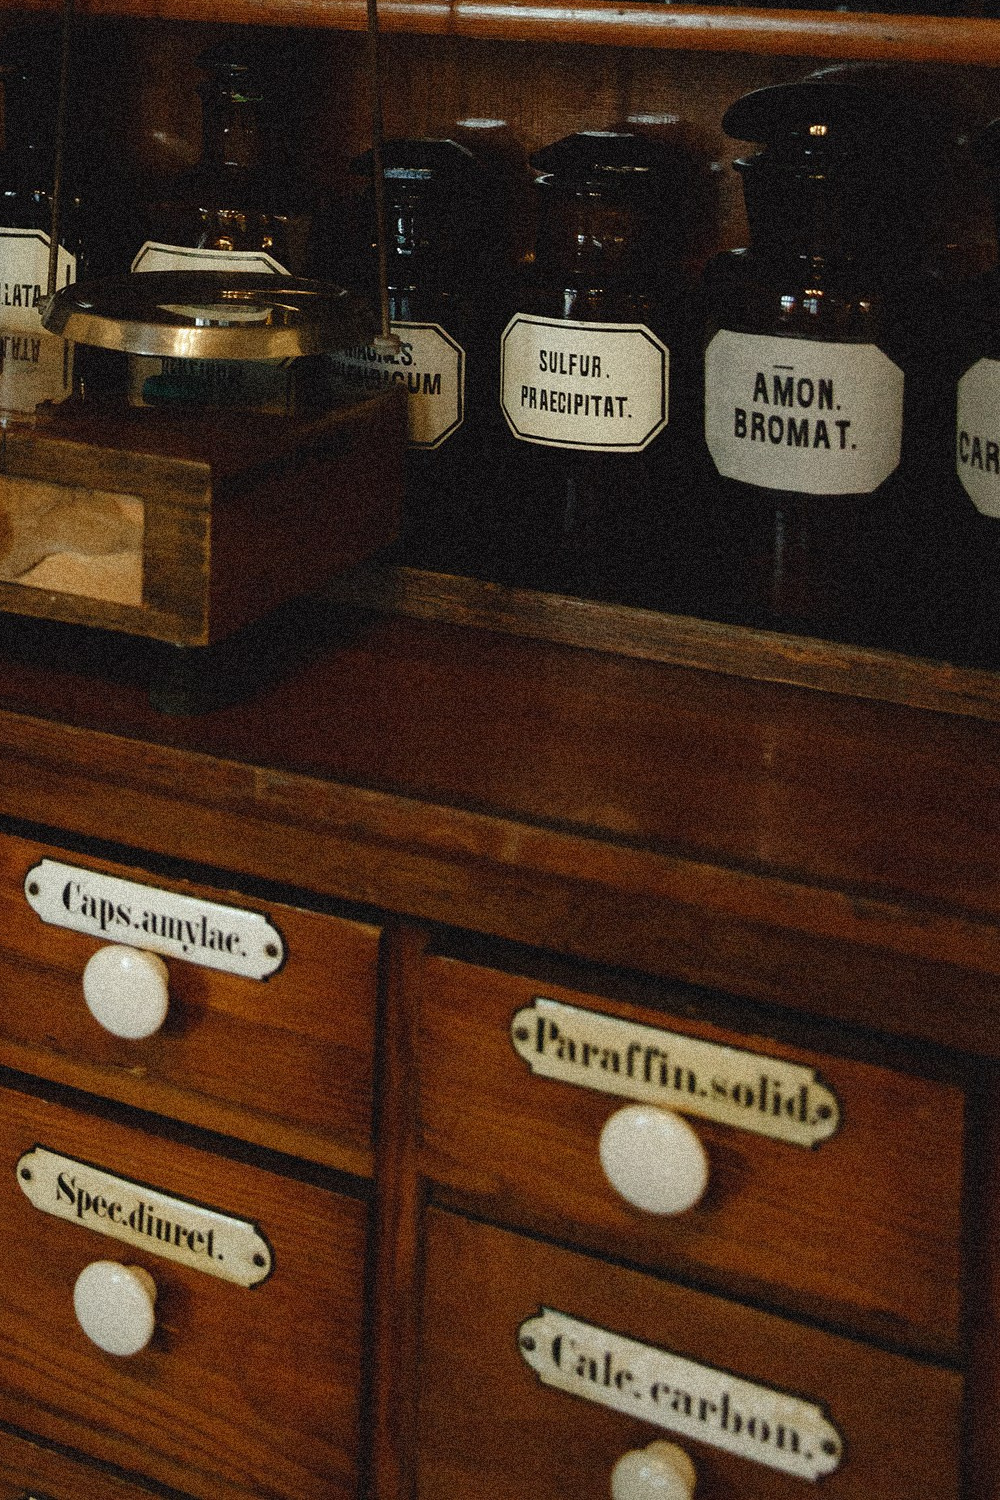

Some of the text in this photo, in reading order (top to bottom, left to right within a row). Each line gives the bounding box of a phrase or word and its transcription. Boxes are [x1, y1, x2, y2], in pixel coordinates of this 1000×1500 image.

[539, 348, 610, 380] SULFUR.
[520, 384, 633, 420] PRAECIPITAT.
[733, 407, 837, 452] BROMAT.
